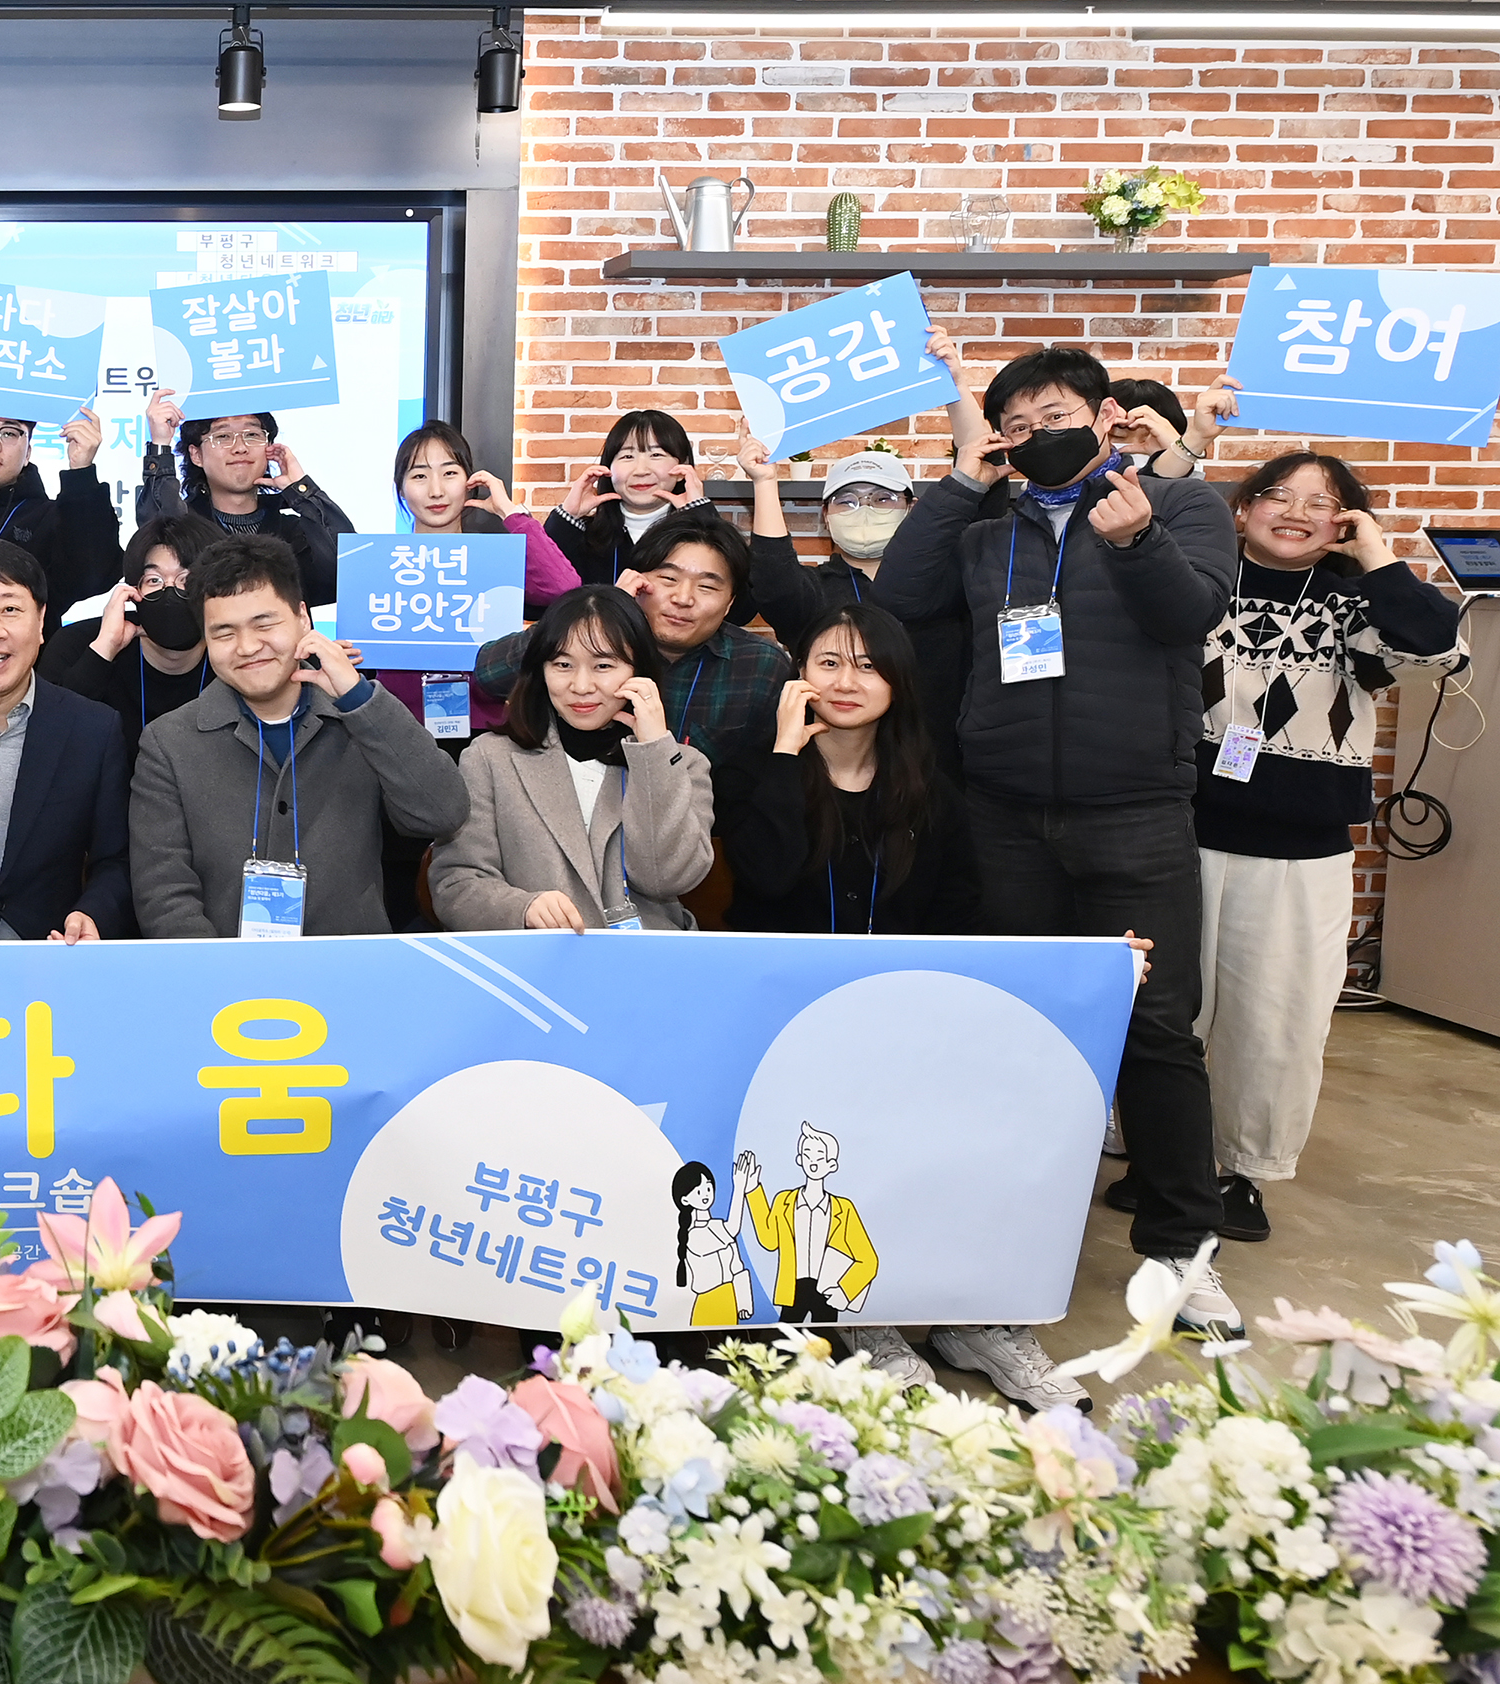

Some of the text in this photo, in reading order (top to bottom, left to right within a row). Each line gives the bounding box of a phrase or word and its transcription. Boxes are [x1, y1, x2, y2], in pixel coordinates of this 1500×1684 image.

[199, 233, 256, 249] 부평구
[219, 253, 335, 269] 청년네트워크
[181, 284, 301, 337] 잘살아
[206, 333, 286, 381] 볼과
[765, 309, 901, 404] 공감
[1277, 298, 1467, 382] 참여
[389, 544, 468, 586] 청년
[368, 591, 492, 633] 방앗간
[465, 1161, 604, 1238] 부평구
[377, 1196, 658, 1318] 청년네트워크
